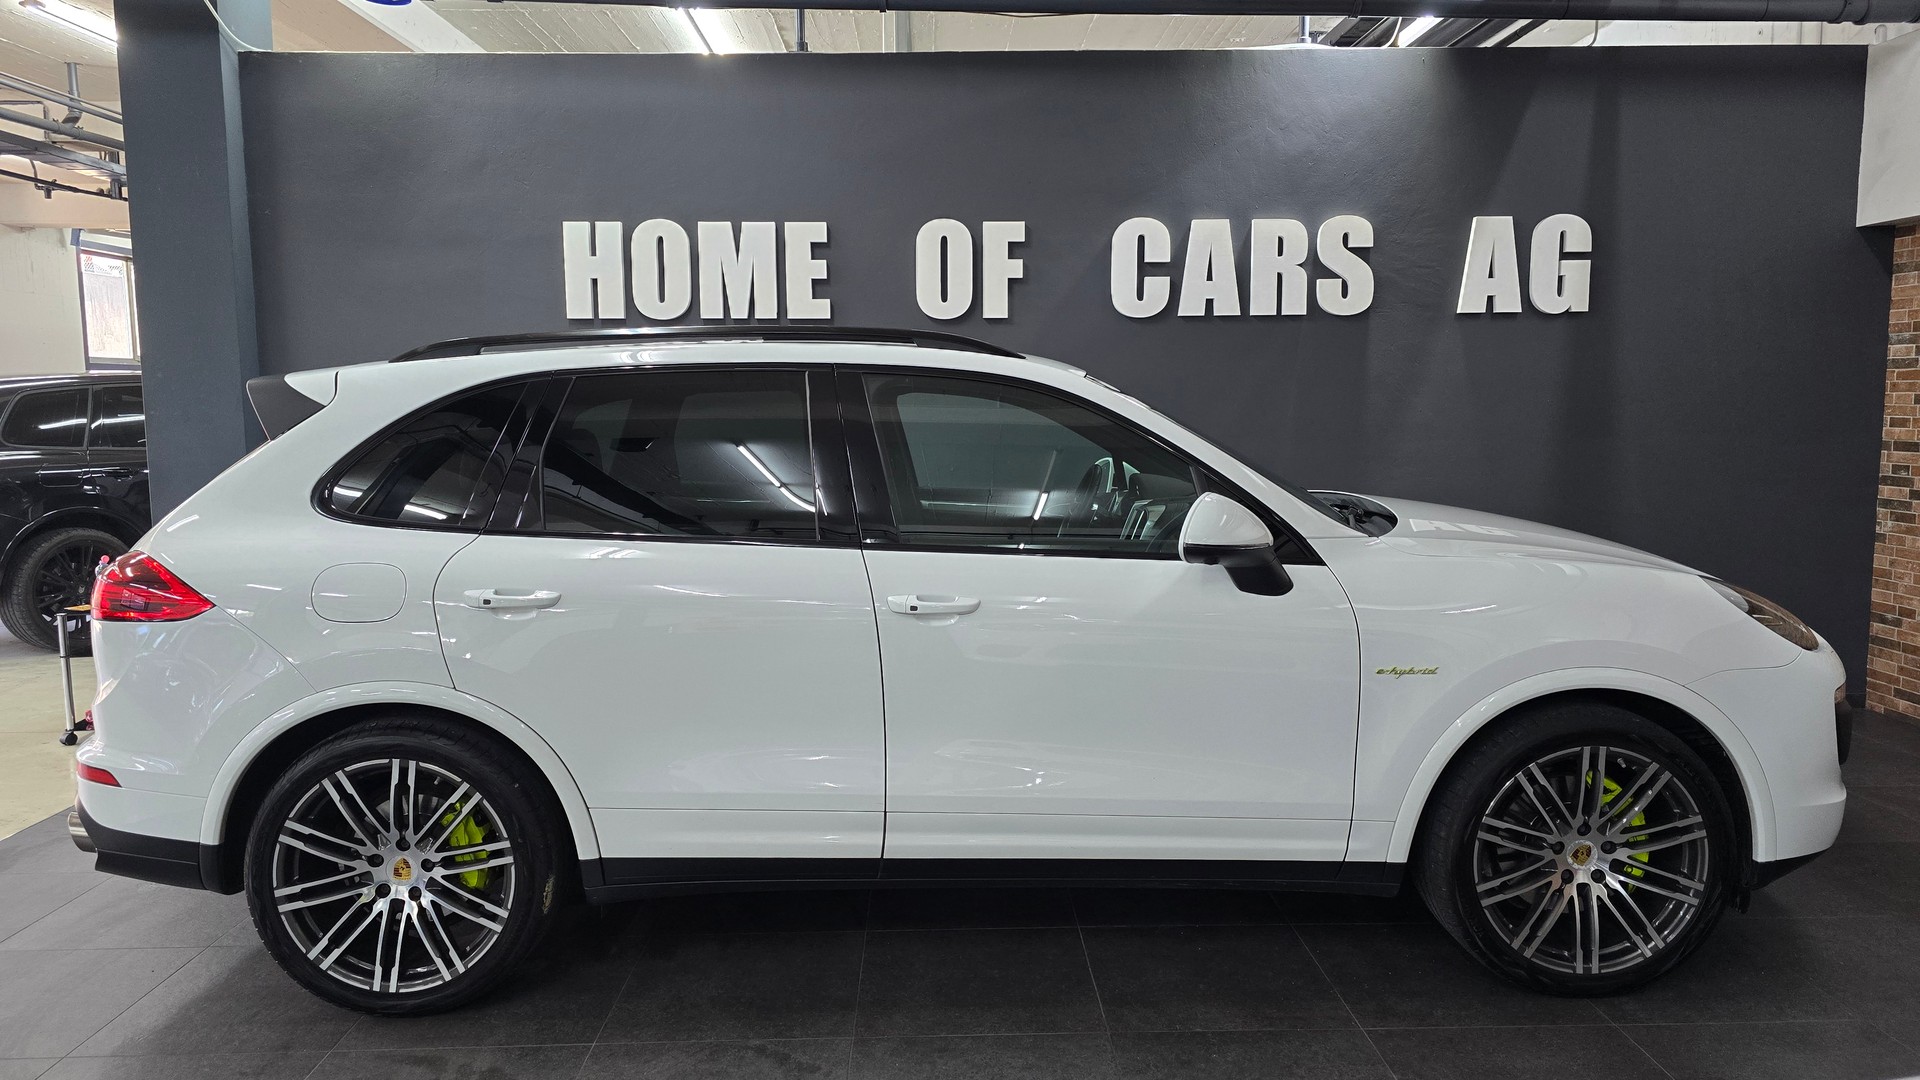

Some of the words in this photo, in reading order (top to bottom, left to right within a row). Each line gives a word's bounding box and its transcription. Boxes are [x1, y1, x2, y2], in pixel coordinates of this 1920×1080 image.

[562, 218, 832, 321] HOME
[915, 218, 1026, 320] OF
[1110, 214, 1375, 319] CARS
[1456, 213, 1593, 315] AG
[1376, 666, 1438, 679] e-hybrid
